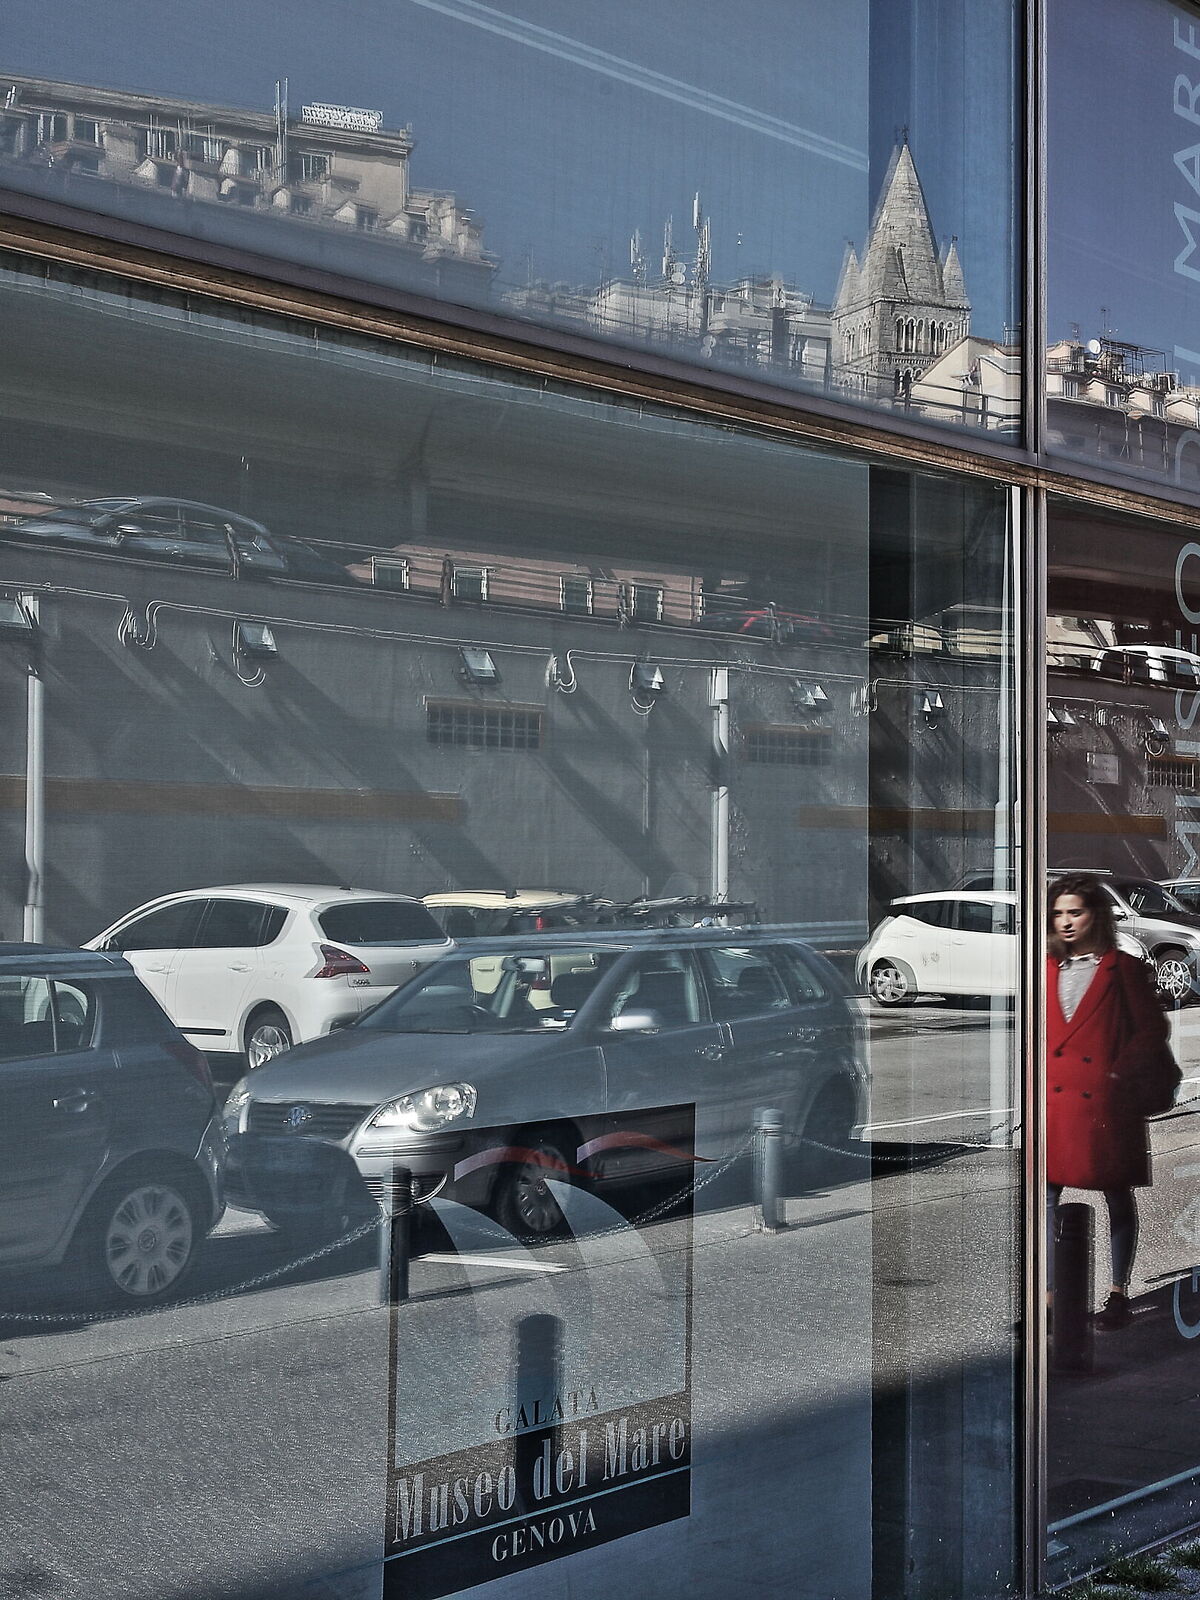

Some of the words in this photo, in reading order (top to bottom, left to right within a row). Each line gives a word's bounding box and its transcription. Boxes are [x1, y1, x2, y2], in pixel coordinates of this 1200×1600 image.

[494, 1386, 600, 1434] GALATA
[392, 1463, 517, 1544] Museo
[533, 1430, 589, 1499] del
[602, 1414, 686, 1481] Mare
[491, 1508, 598, 1562] GENOVA
